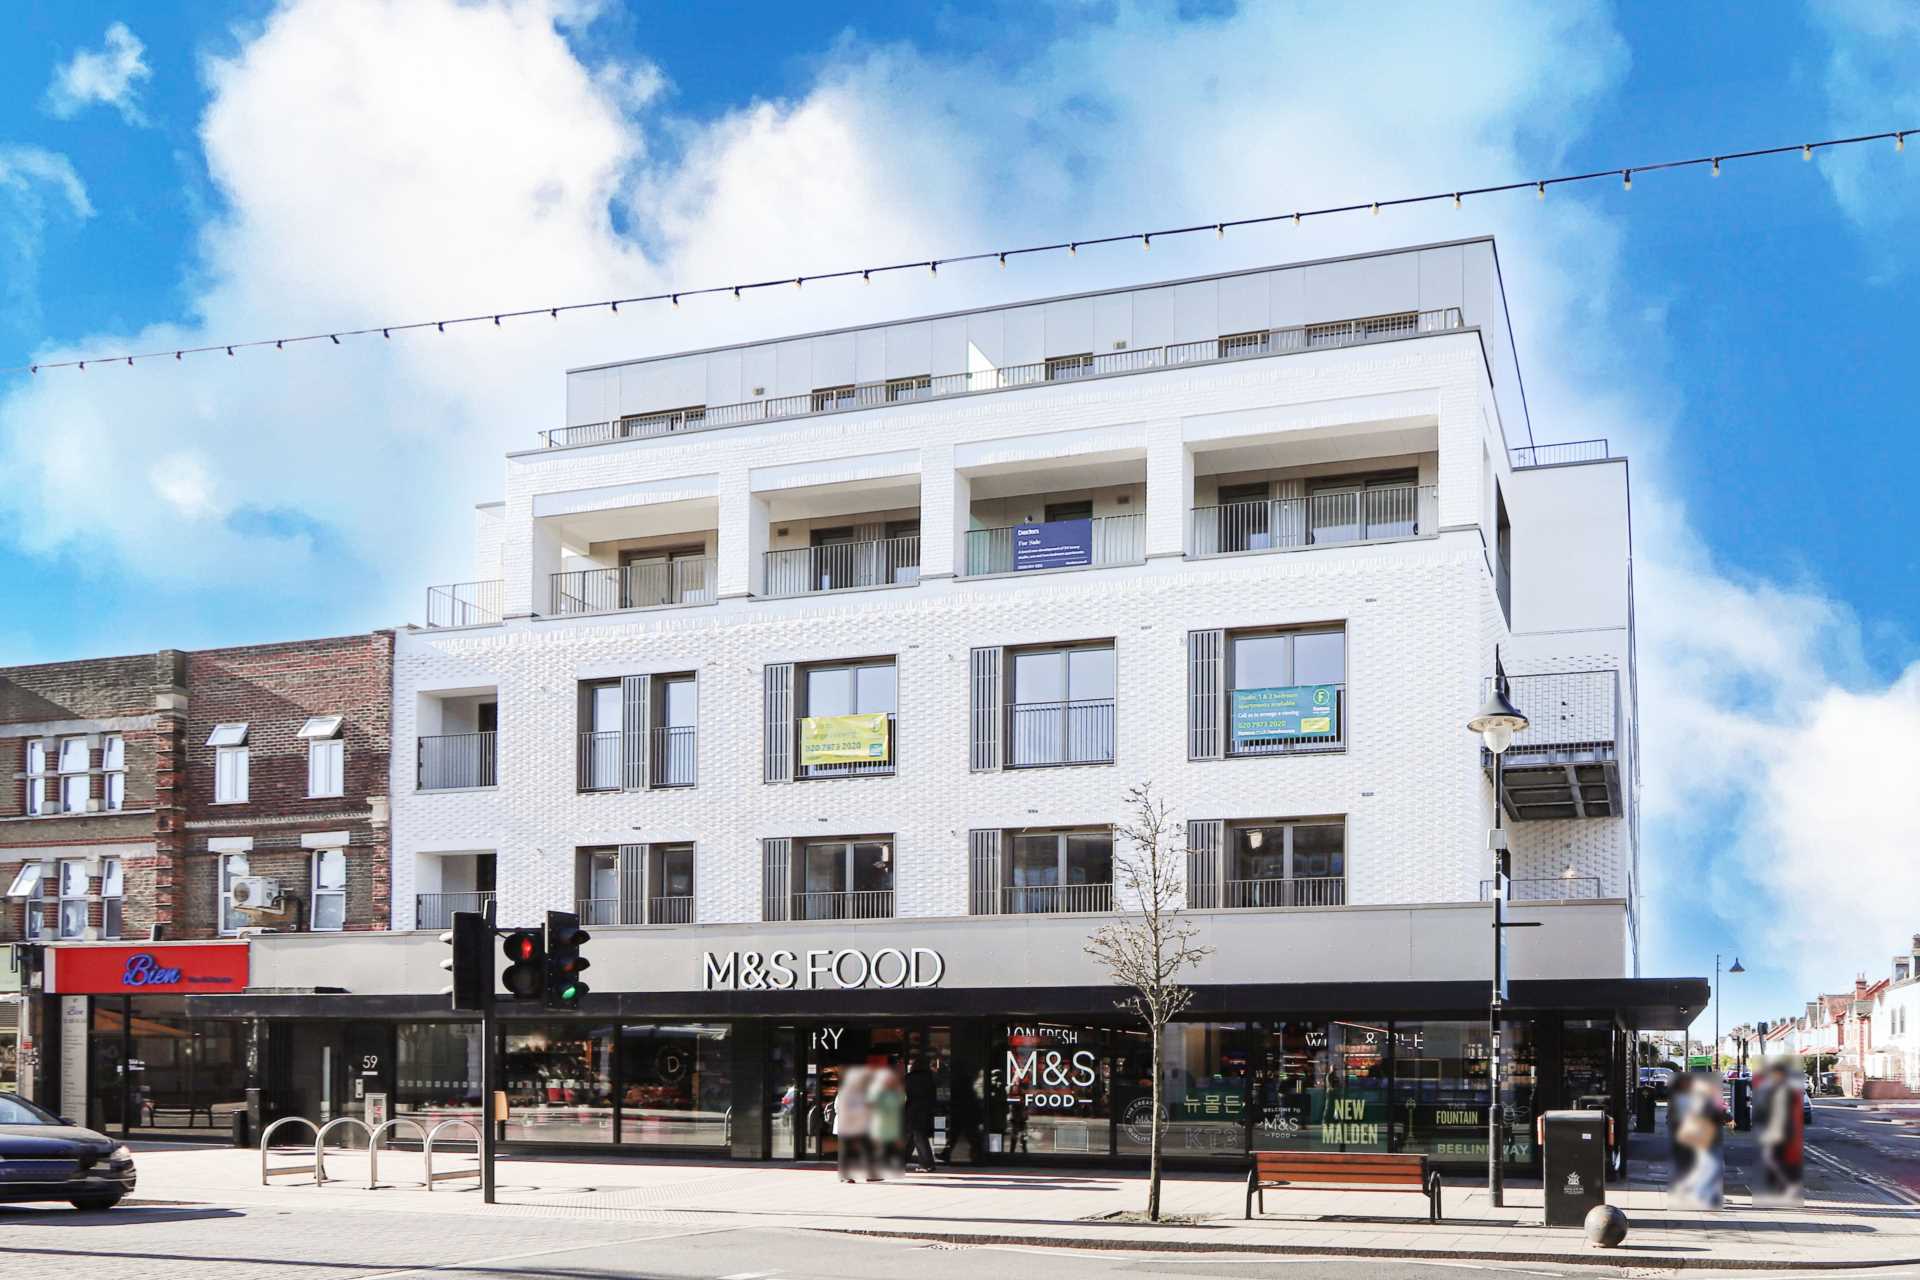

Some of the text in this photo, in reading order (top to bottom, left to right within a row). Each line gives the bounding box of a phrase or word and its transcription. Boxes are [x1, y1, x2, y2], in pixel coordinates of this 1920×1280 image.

[122, 952, 182, 986] Bien
[703, 947, 945, 990] M&S FOOD
[362, 1055, 378, 1069] 59
[1006, 1050, 1095, 1087] M&S
[1025, 1094, 1075, 1107] FOOD
[1184, 1095, 1242, 1114] 뉴몰든
[1334, 1099, 1366, 1120] NEW
[1264, 1117, 1299, 1131] M&S
[1435, 1110, 1479, 1125] FOUNTAIN
[1322, 1123, 1379, 1145] MALDEN
